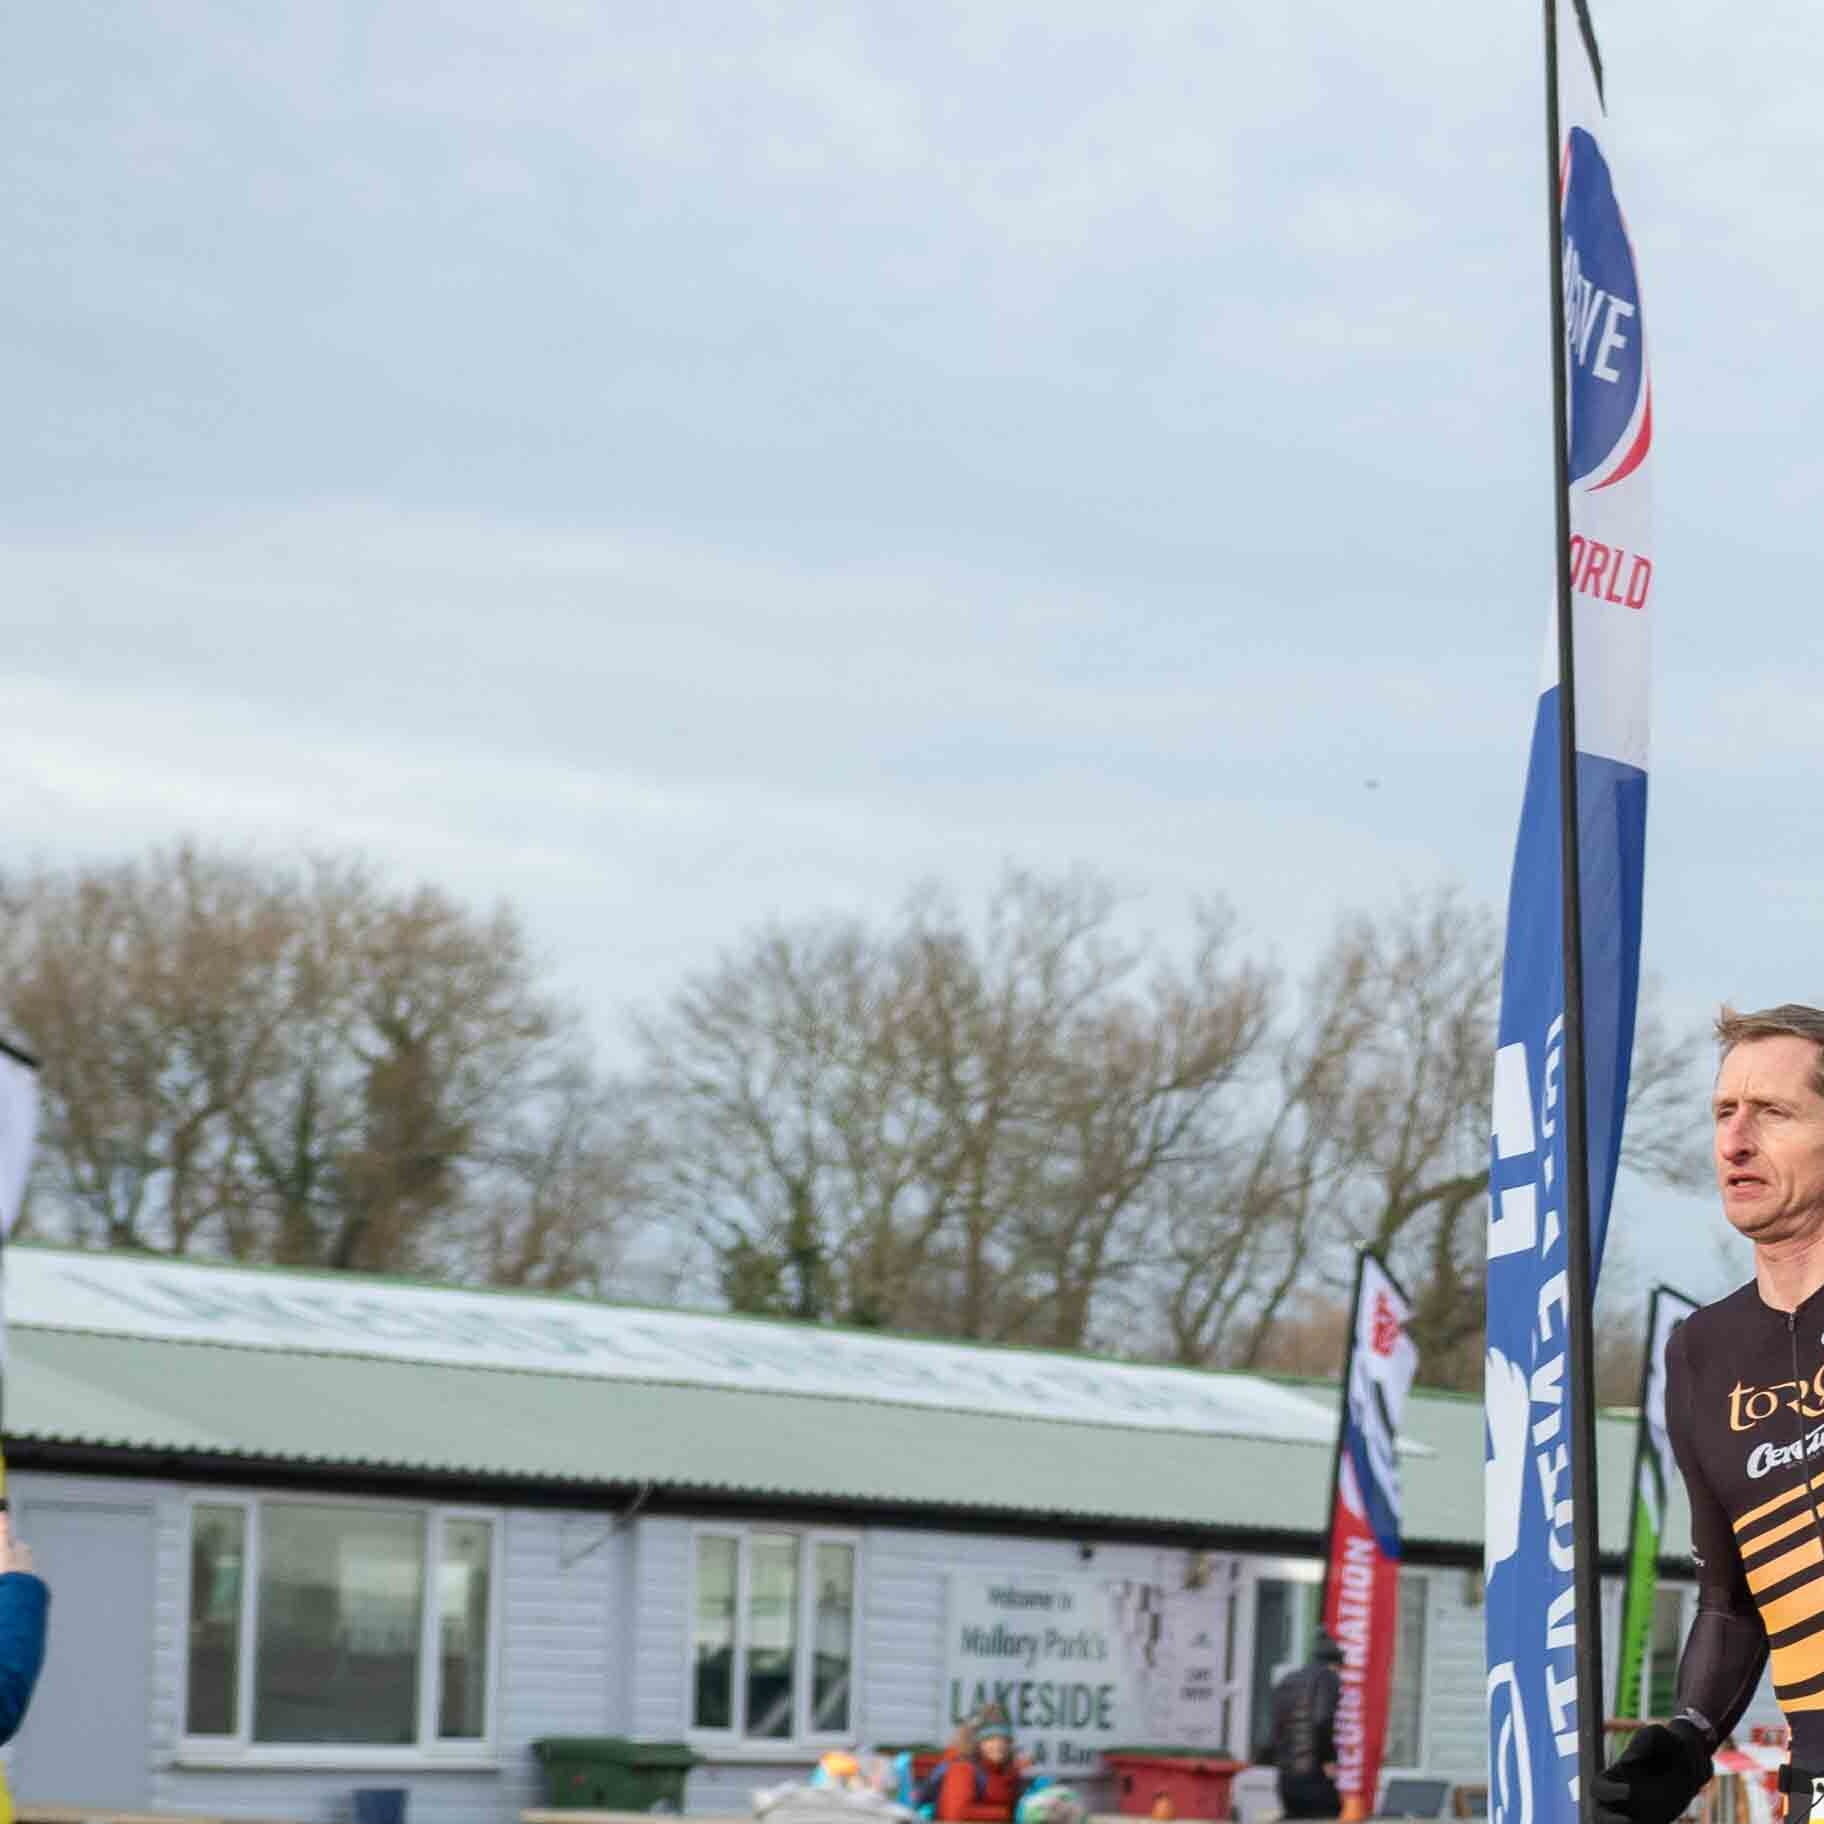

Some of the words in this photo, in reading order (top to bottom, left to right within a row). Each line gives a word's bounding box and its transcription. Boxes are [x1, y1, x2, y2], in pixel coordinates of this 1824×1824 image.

[1570, 534, 1652, 609] ORLD
[961, 1624, 1038, 1669] Mallory
[950, 1680, 1116, 1730] LAKESIDE
